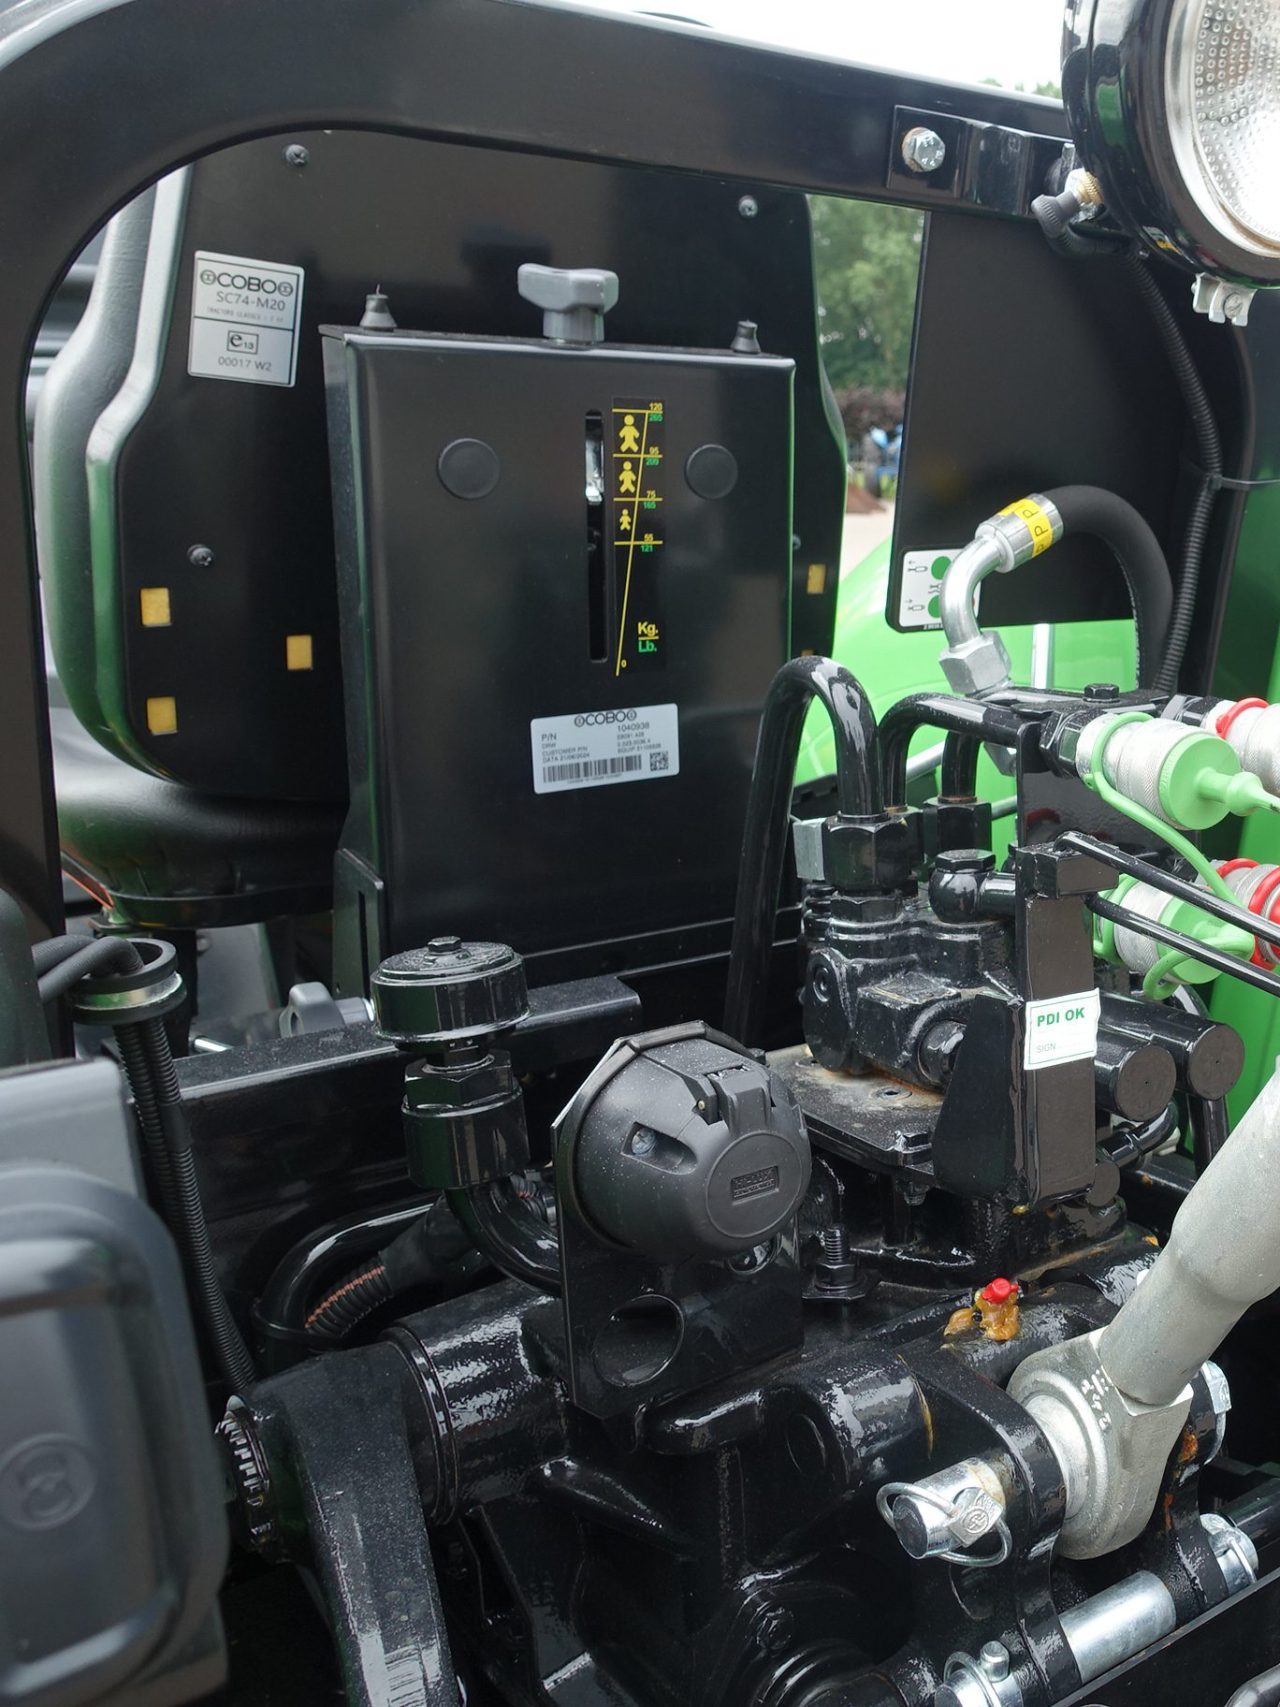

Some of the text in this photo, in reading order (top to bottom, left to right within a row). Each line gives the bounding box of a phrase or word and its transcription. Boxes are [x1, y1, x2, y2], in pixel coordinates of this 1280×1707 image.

[216, 291, 286, 312] SC74-M20
[217, 356, 272, 372] 00017 W2
[650, 402, 663, 411] 120
[646, 490, 656, 498] 75
[641, 544, 653, 553] 121
[638, 621, 659, 637] Kg.
[638, 640, 657, 652] Lb.
[541, 733, 557, 742] P/N
[1036, 1006, 1086, 1028] PDI OK
[1036, 1041, 1057, 1054] SIGN
